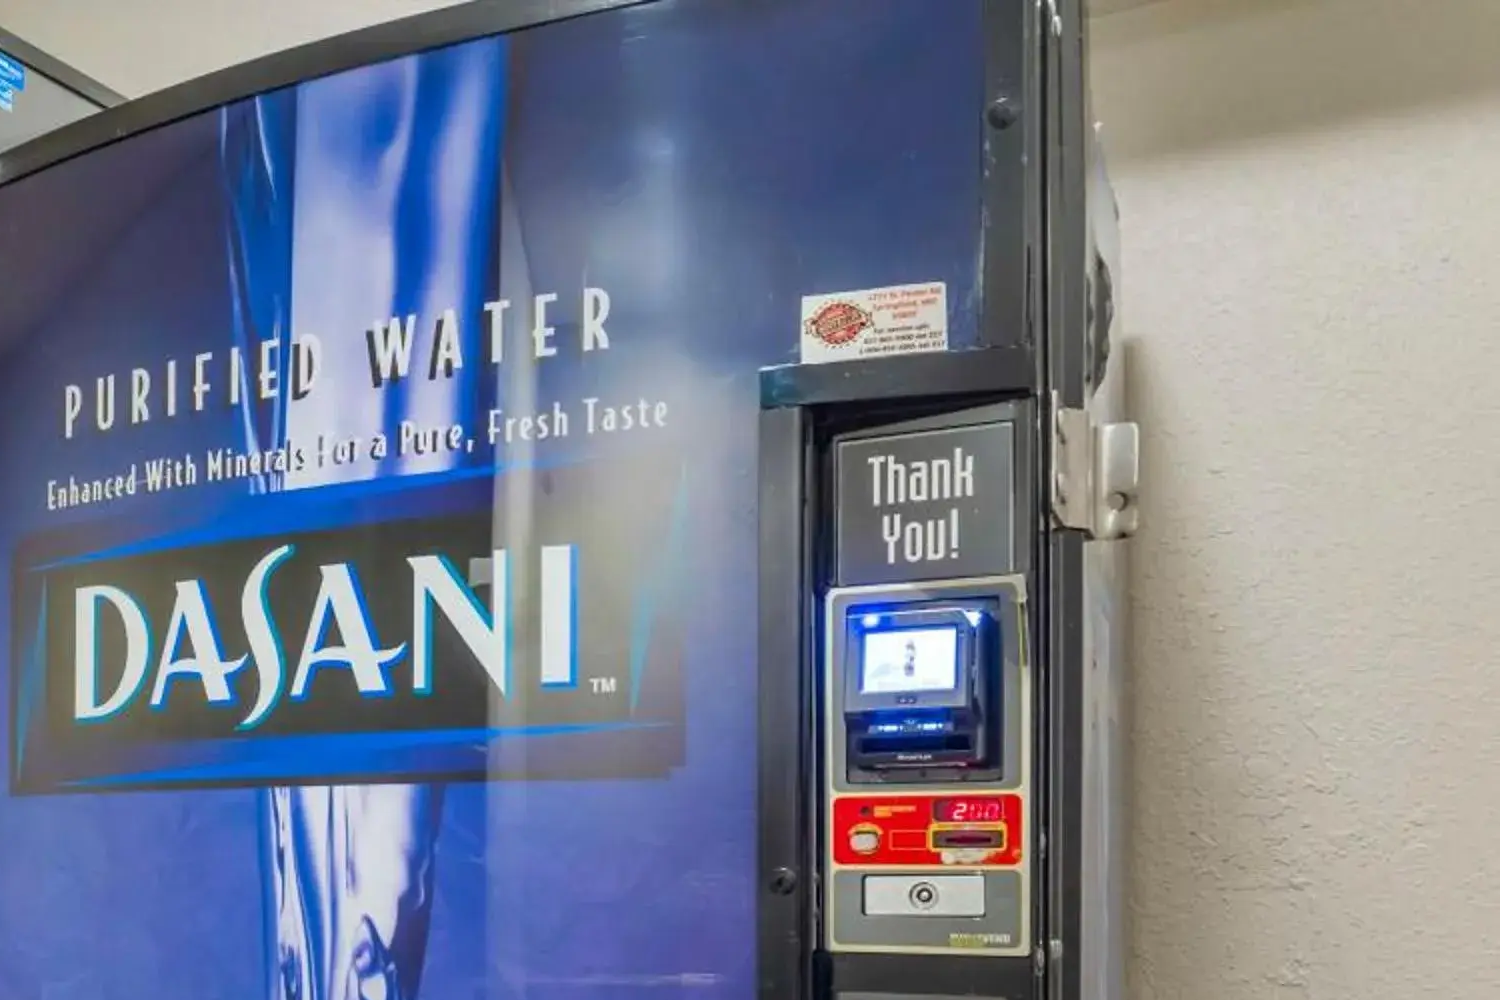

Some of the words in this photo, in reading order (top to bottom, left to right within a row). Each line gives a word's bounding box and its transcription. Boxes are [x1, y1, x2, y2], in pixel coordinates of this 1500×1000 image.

[65, 334, 322, 438] PURIFIED
[368, 287, 611, 387] WATER
[47, 464, 137, 511] Enhanced
[145, 453, 197, 492] With
[207, 439, 304, 482] Minerals
[318, 433, 361, 468] For
[369, 431, 387, 461] a
[396, 420, 474, 457] Pure,
[488, 402, 568, 445] Fresh
[583, 397, 668, 434] Taste
[867, 447, 974, 506] Thank
[882, 508, 960, 565] You!
[75, 543, 578, 731] DASANI
[589, 677, 617, 694] TM
